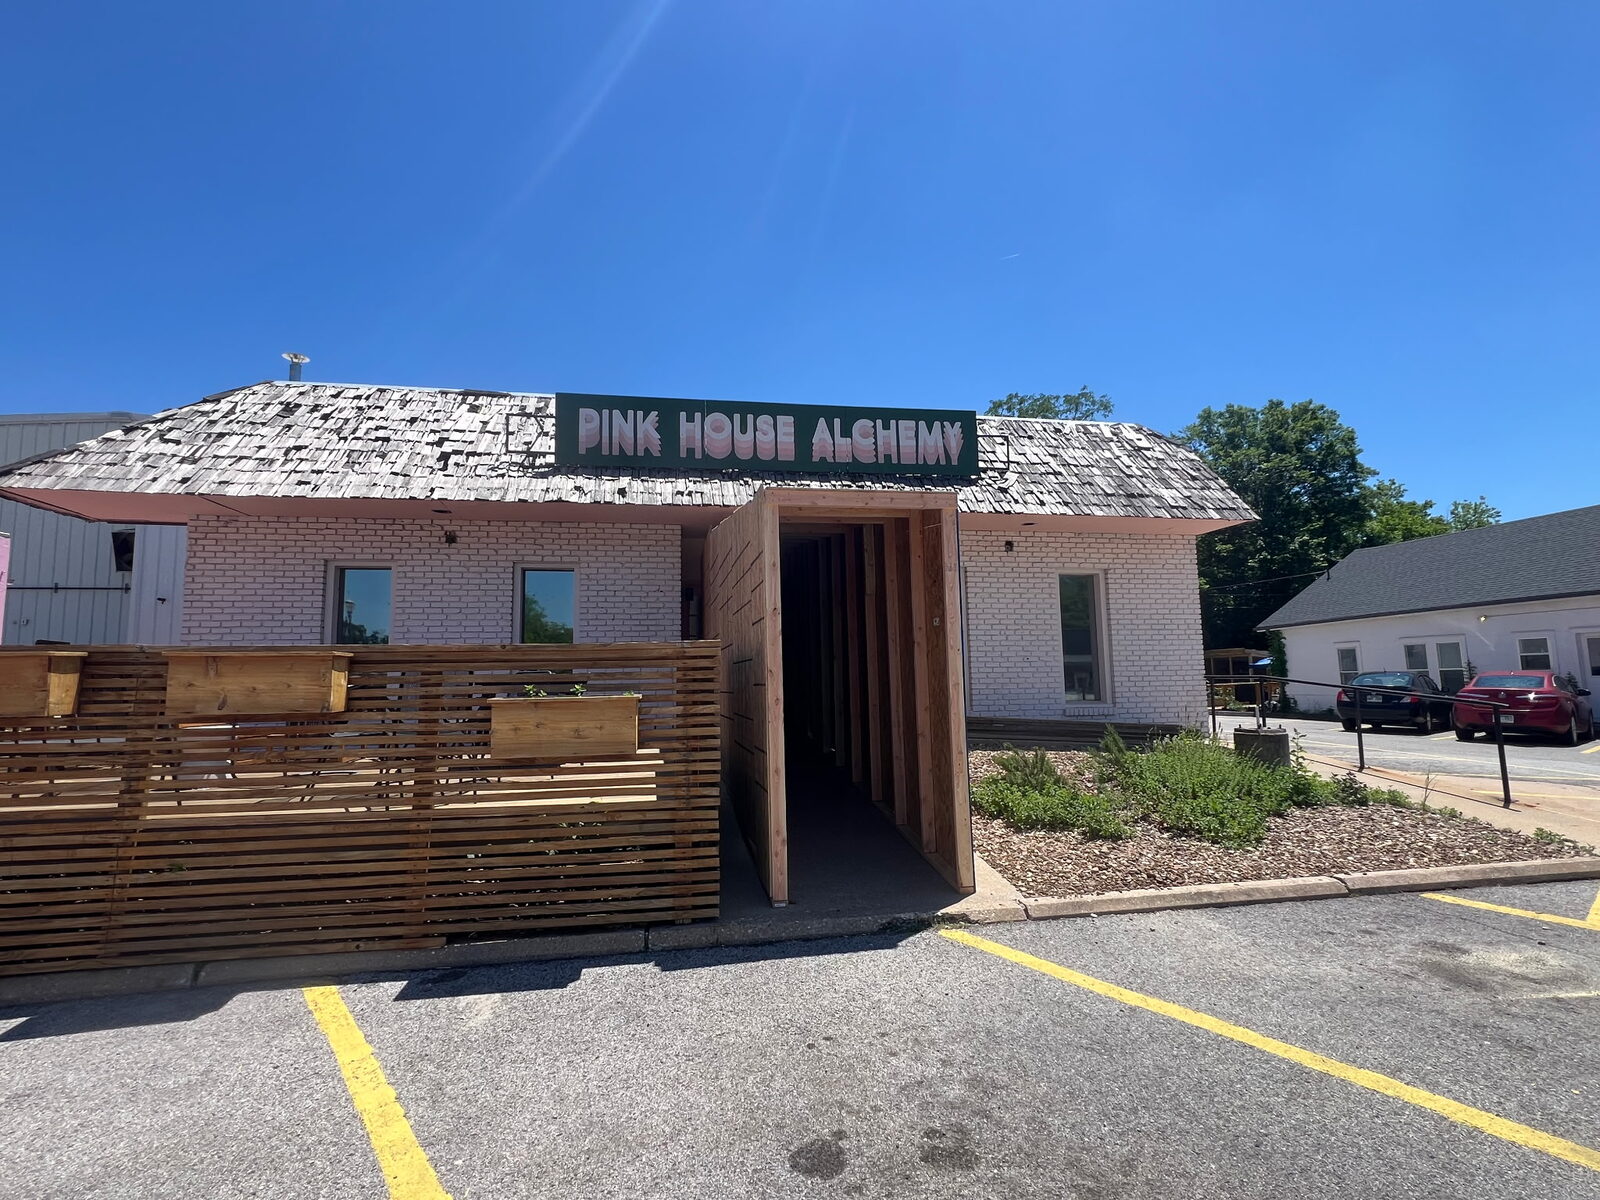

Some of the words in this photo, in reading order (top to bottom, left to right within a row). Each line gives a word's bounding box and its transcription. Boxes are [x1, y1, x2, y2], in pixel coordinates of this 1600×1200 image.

[578, 408, 661, 456] PINK
[679, 411, 795, 461] HOUSE
[812, 417, 964, 465] ALCHEMY
